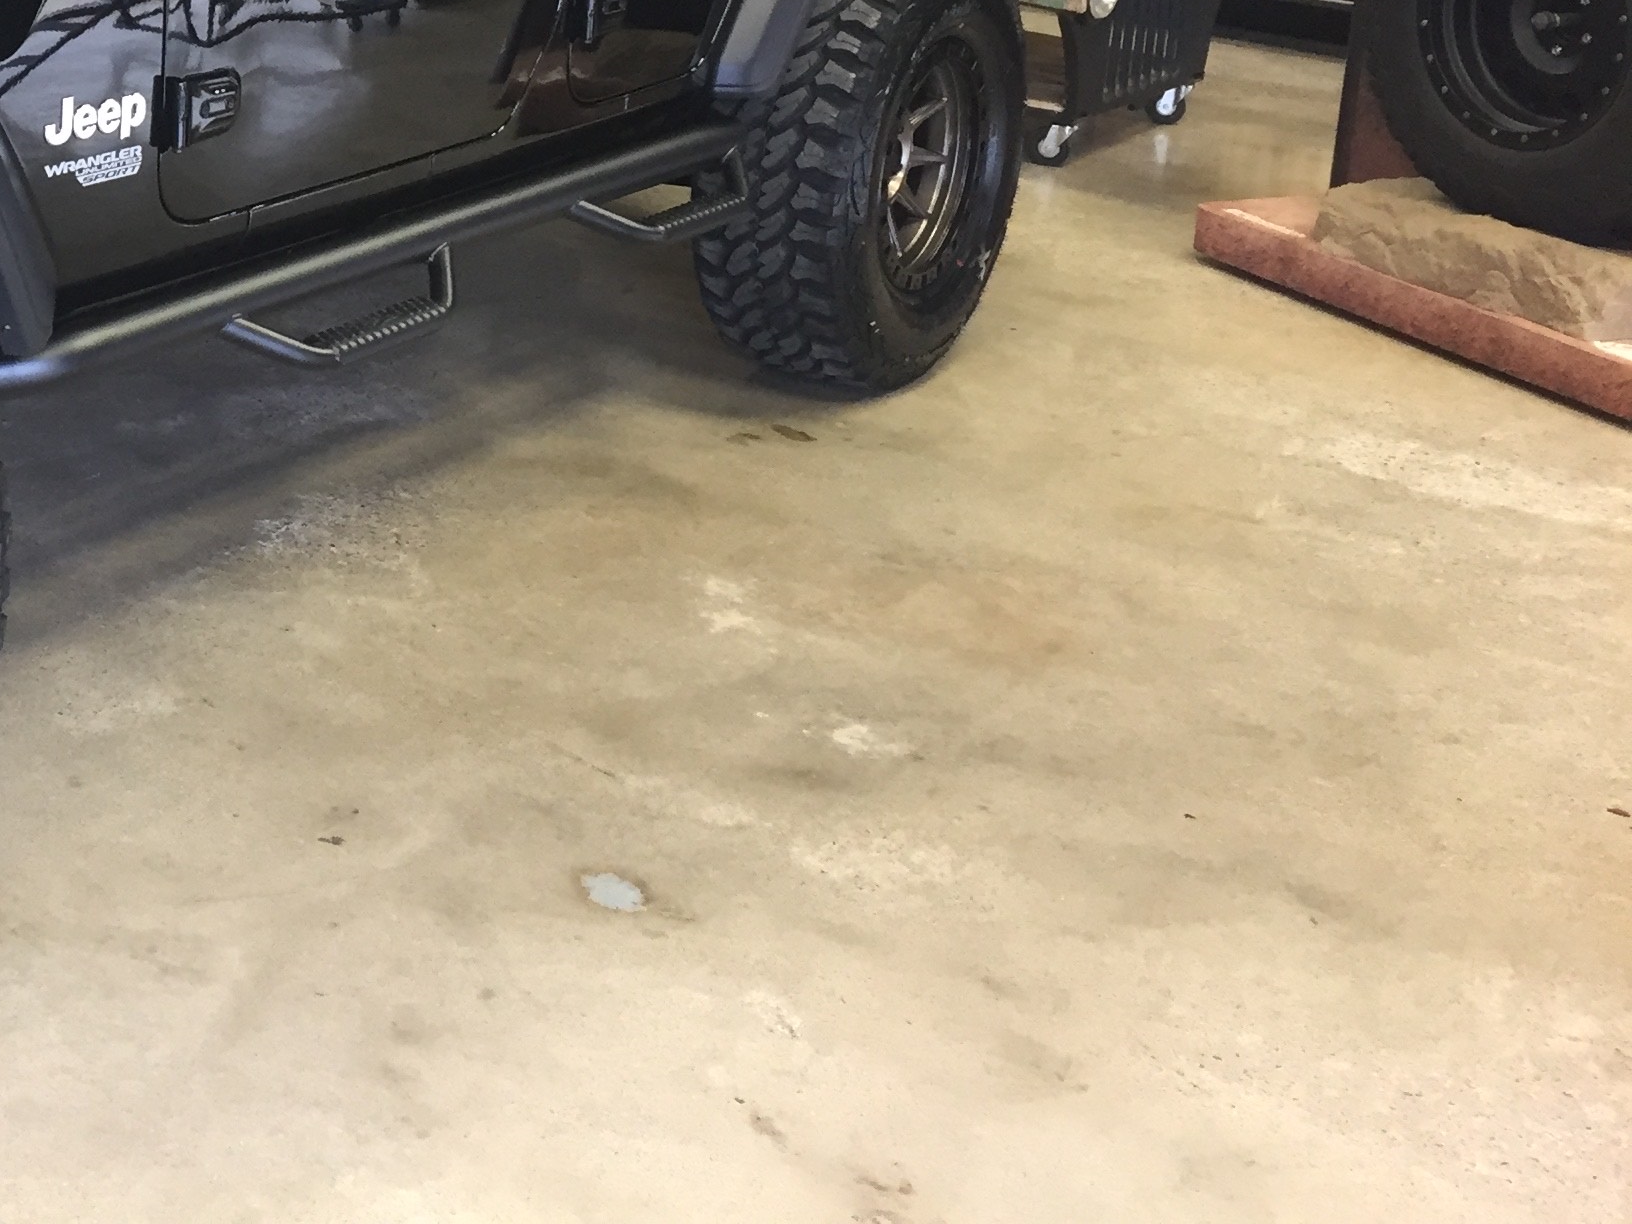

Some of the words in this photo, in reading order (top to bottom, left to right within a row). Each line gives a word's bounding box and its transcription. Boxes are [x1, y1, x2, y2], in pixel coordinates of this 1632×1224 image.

[45, 92, 146, 146] Jeep
[44, 145, 143, 178] WRANGLER
[76, 156, 142, 176] UNLIMITED
[82, 165, 139, 183] SPORT
